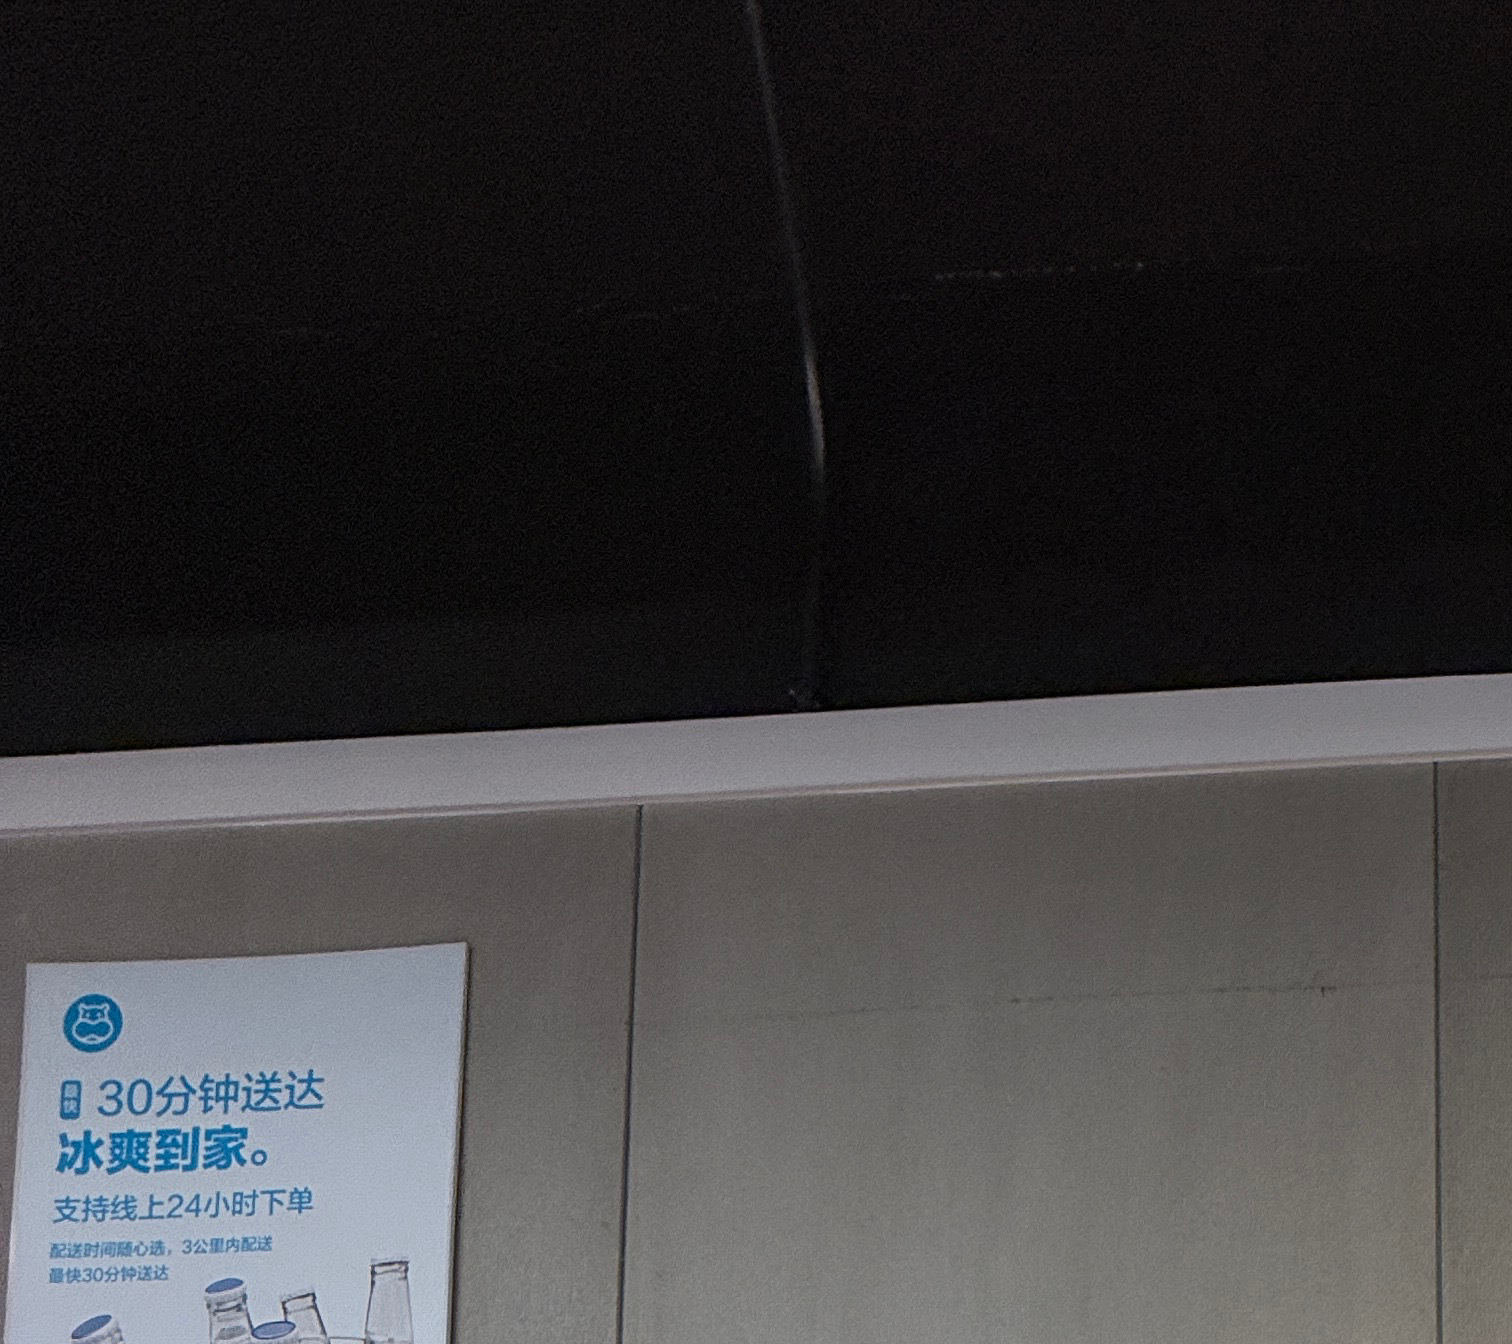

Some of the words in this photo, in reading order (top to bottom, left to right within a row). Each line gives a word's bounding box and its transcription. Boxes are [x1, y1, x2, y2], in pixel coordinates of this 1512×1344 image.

[98, 1069, 326, 1118] 30分钟送达
[56, 1125, 270, 1176] 冰爽到家。
[53, 1188, 314, 1224] 支持线上24小时下单
[48, 1264, 169, 1285] 最快30分钟送达
